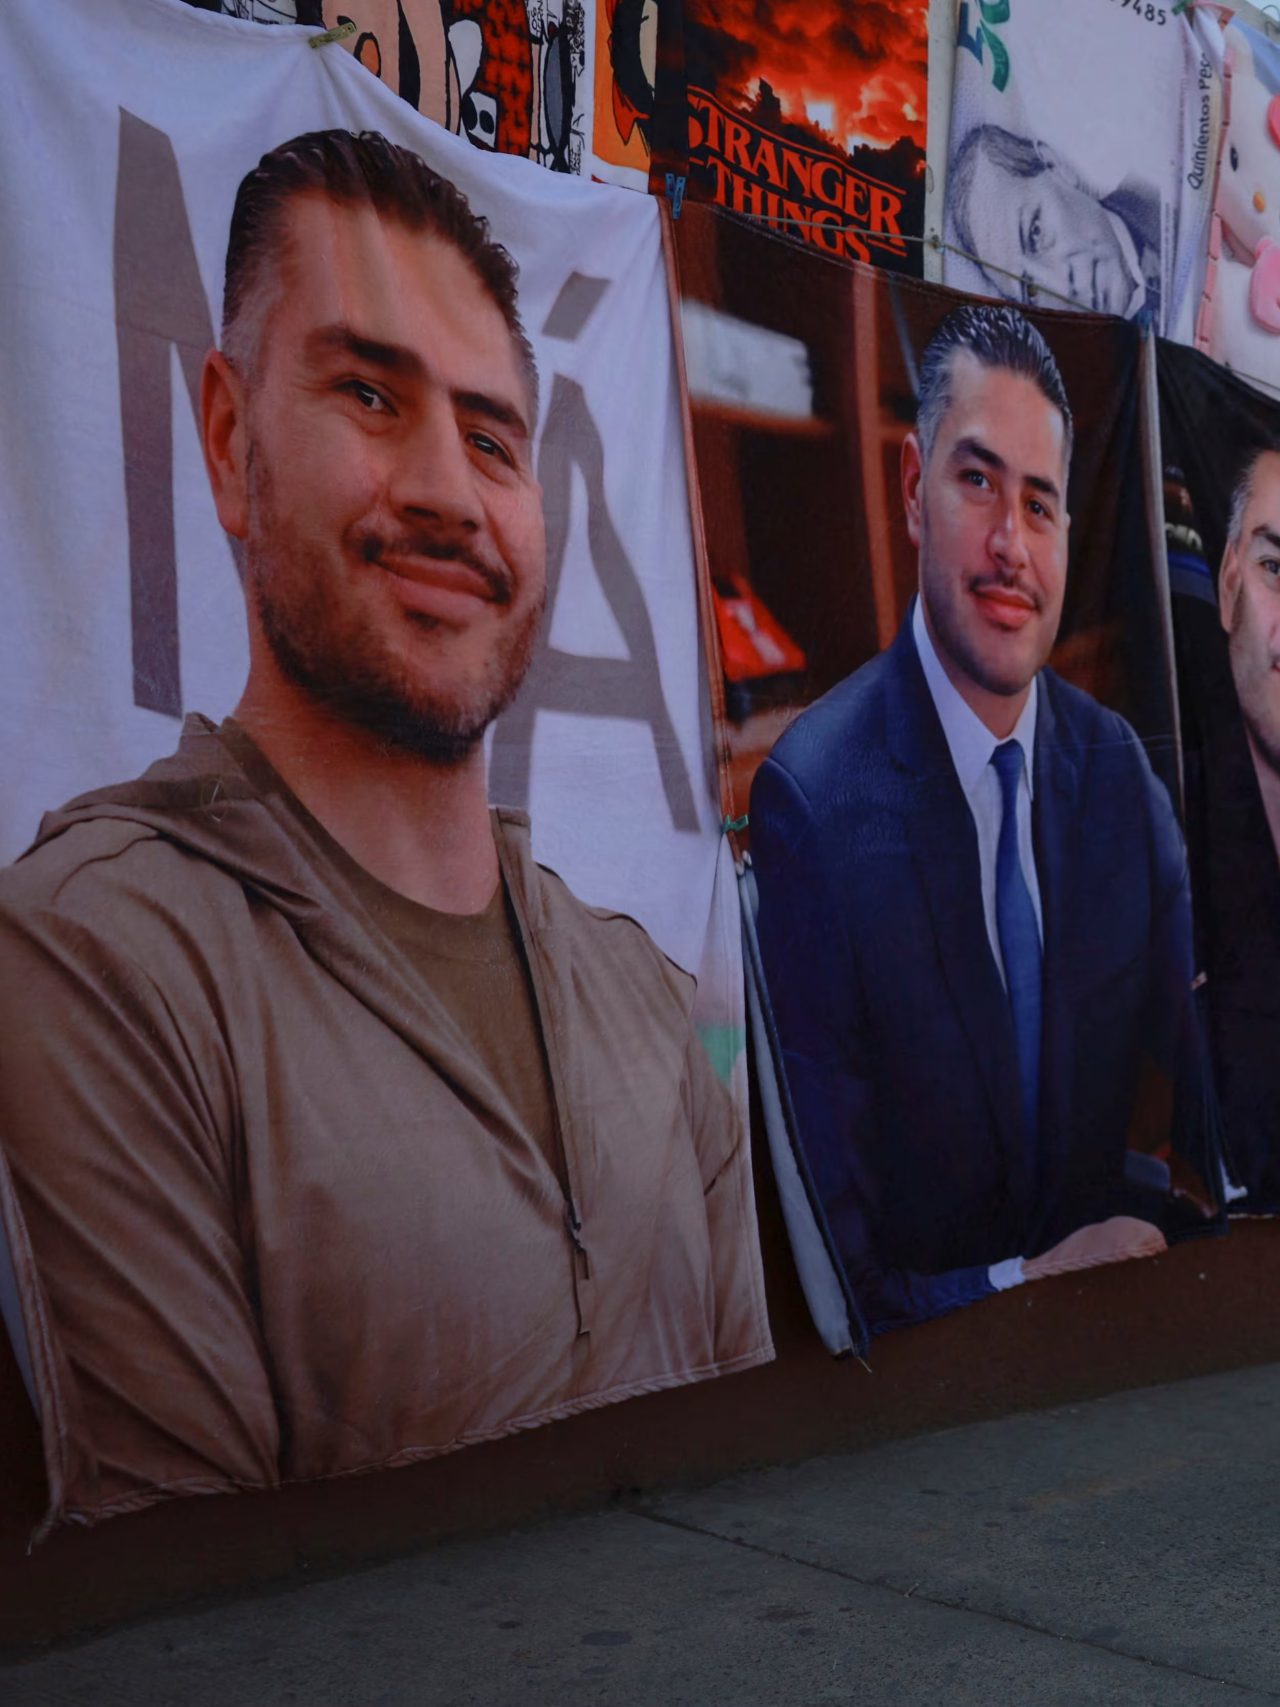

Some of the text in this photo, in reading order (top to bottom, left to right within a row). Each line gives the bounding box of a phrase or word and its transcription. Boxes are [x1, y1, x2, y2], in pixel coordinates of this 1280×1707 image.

[1120, 0, 1167, 26] 485
[1187, 94, 1211, 190] Quinientos
[706, 155, 872, 265] THINGS
